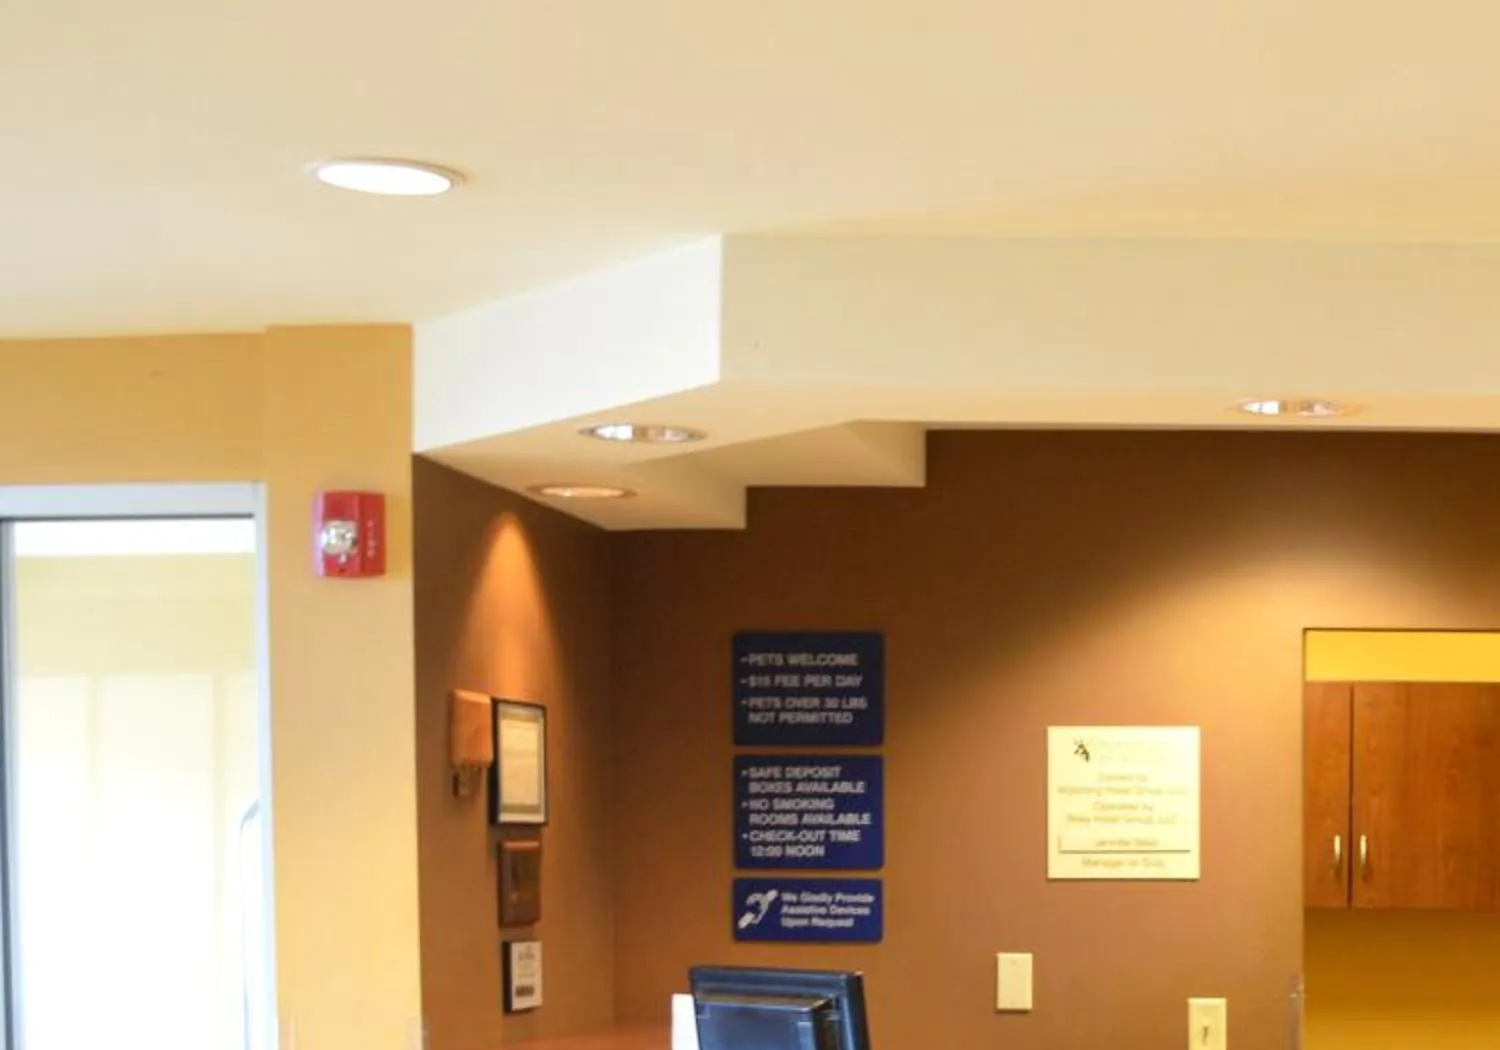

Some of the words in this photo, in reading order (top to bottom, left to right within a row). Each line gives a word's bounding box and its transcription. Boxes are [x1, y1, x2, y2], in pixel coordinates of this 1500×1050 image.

[748, 653, 783, 666] PETS
[787, 653, 859, 666] WELCOME
[774, 675, 800, 687] FEE
[804, 675, 832, 687] PER
[835, 675, 864, 687] DAY
[748, 697, 782, 710] PETS
[785, 697, 819, 710] OVER
[748, 711, 776, 724] NOT
[779, 711, 854, 724] PERMITTED
[749, 766, 782, 778] SAFE
[785, 766, 841, 778] DEPOSIT
[749, 781, 793, 793] BOXES
[796, 781, 865, 793] AVAILABLE
[749, 798, 770, 810] NO
[773, 798, 835, 810] SMOKING
[749, 813, 798, 825] ROOMS
[802, 813, 871, 825] AVAILABLE
[749, 830, 826, 842] CHECK-OUT
[829, 830, 861, 842] TIME
[785, 845, 825, 857] NOON
